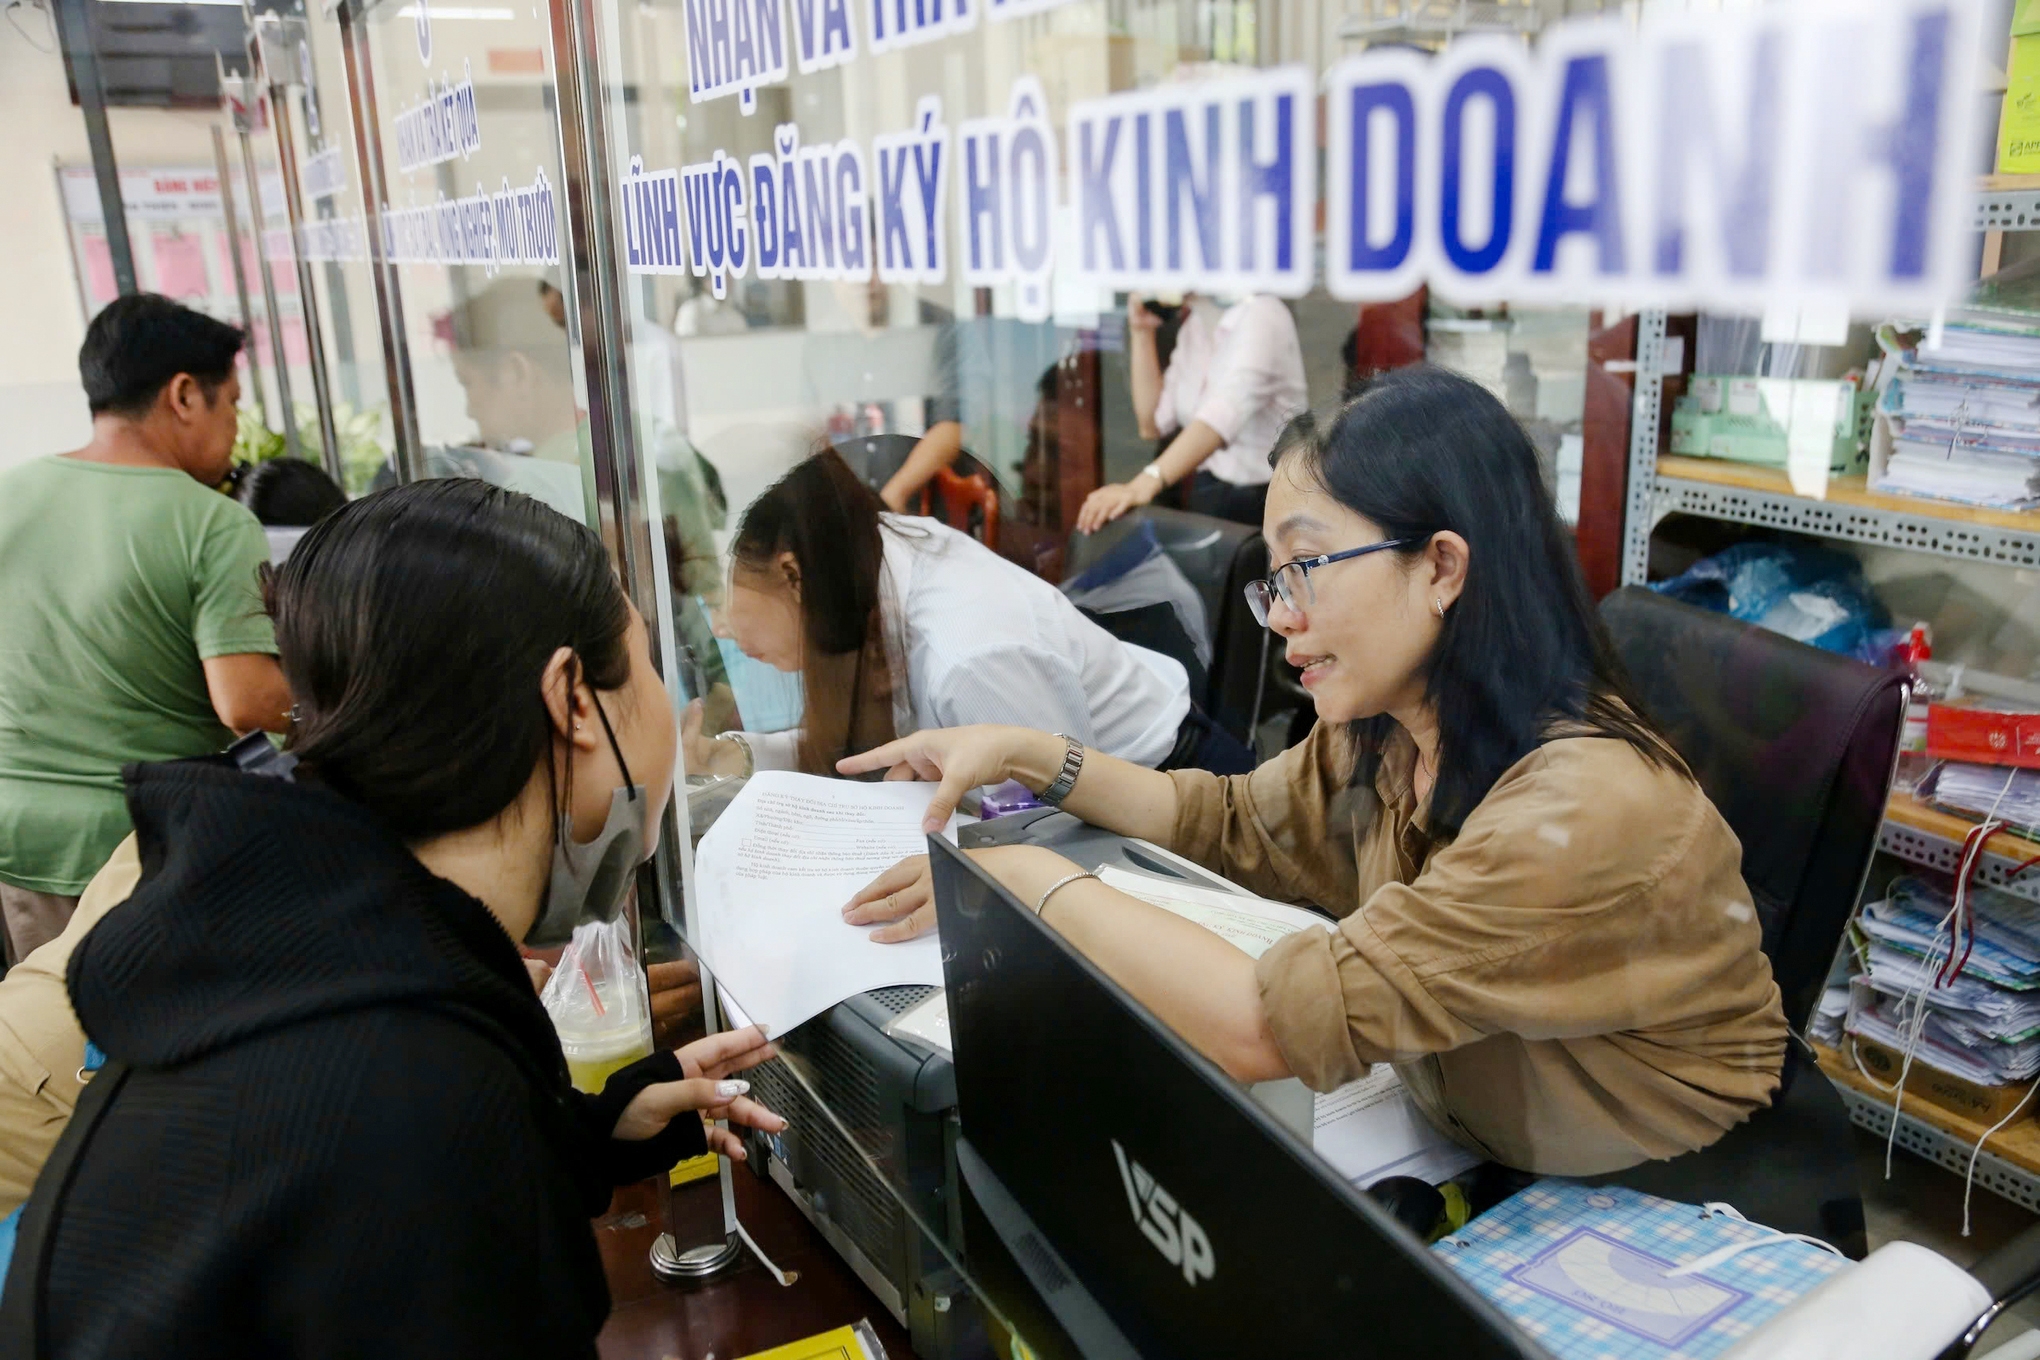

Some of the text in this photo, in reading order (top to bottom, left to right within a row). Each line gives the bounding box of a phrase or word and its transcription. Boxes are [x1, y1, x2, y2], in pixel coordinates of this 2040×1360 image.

[622, 13, 1950, 305] LĨNH VỰC ĐĂNG KÝ HỘ KINH DOANH
